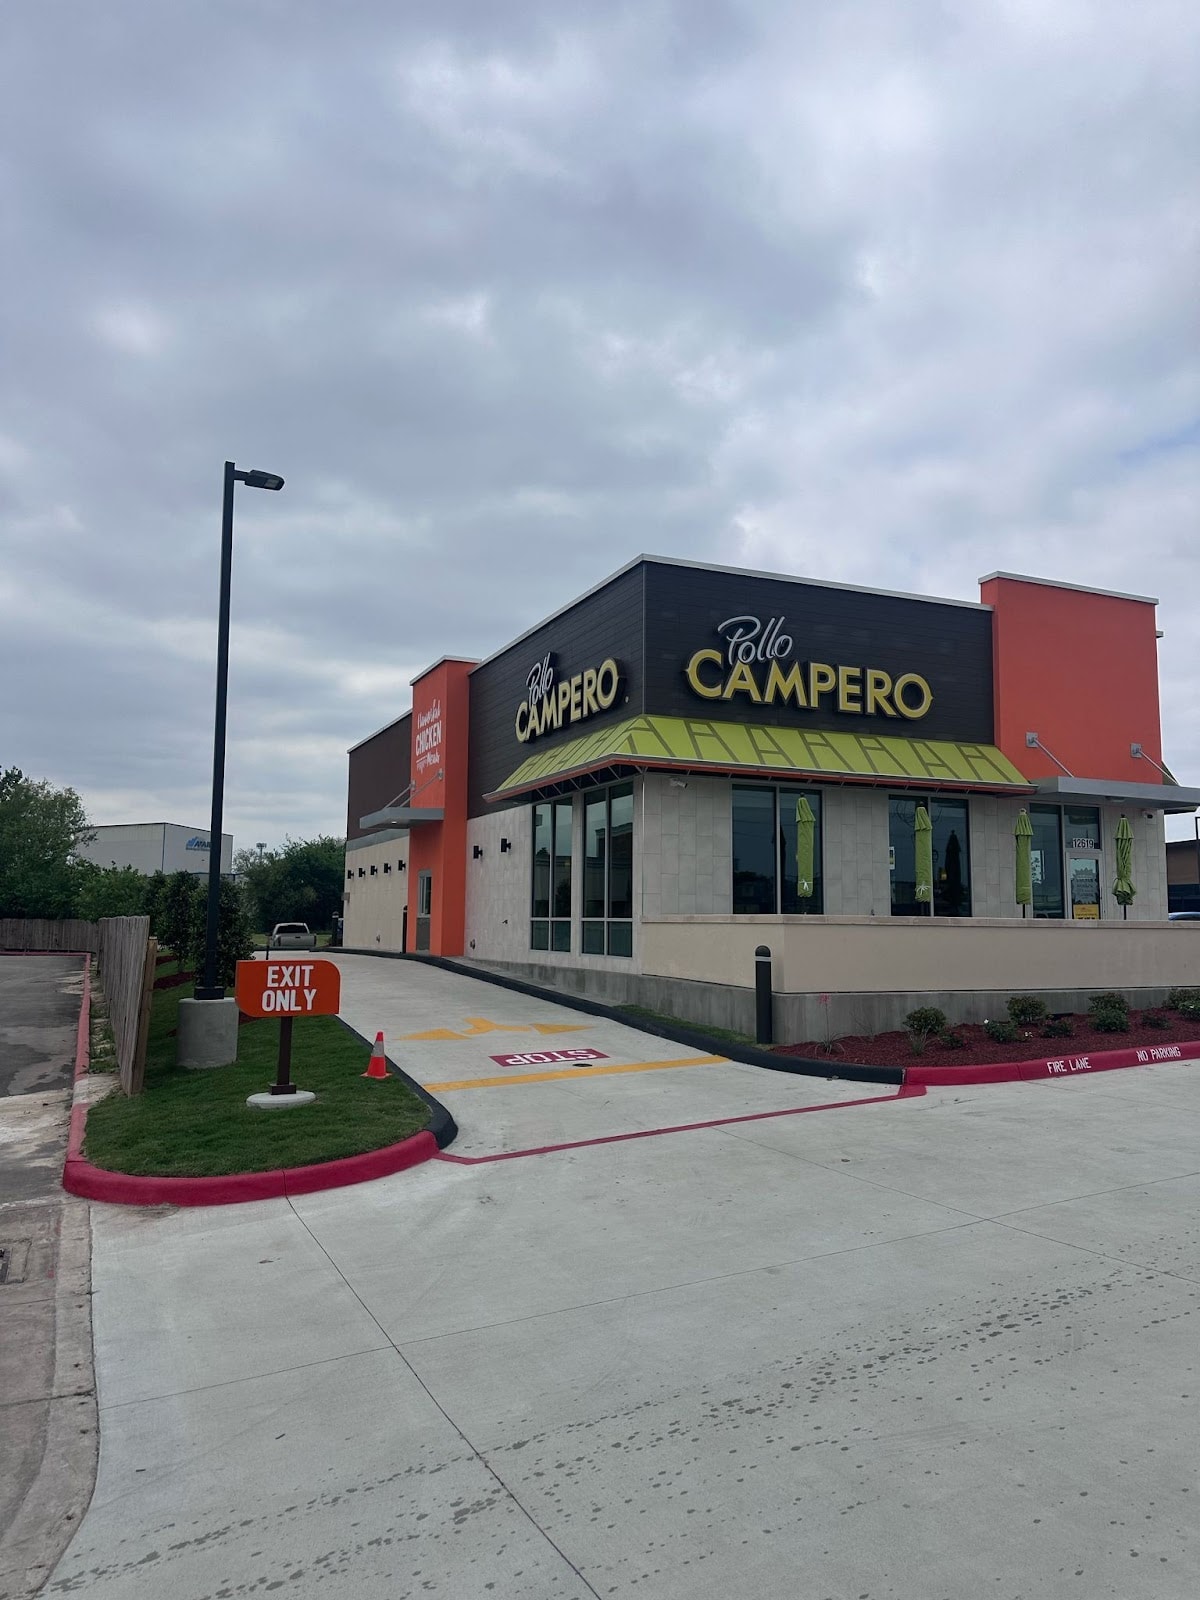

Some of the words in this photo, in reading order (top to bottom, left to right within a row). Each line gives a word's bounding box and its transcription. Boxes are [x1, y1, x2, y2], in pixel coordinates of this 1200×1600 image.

[717, 615, 793, 665] Pollo
[525, 651, 554, 710] Pollo
[683, 648, 934, 720] CAMPERO
[515, 657, 619, 743] CAMPERO
[416, 720, 442, 756] CHICKEN
[1073, 838, 1094, 848] 12619
[267, 965, 314, 988] EXIT
[261, 988, 317, 1012] ONLY
[506, 1050, 598, 1065] STOP
[1047, 1061, 1067, 1074] FIRE
[1069, 1058, 1092, 1071] LANE
[1137, 1050, 1149, 1062] NO
[1151, 1047, 1181, 1061] PARKING
